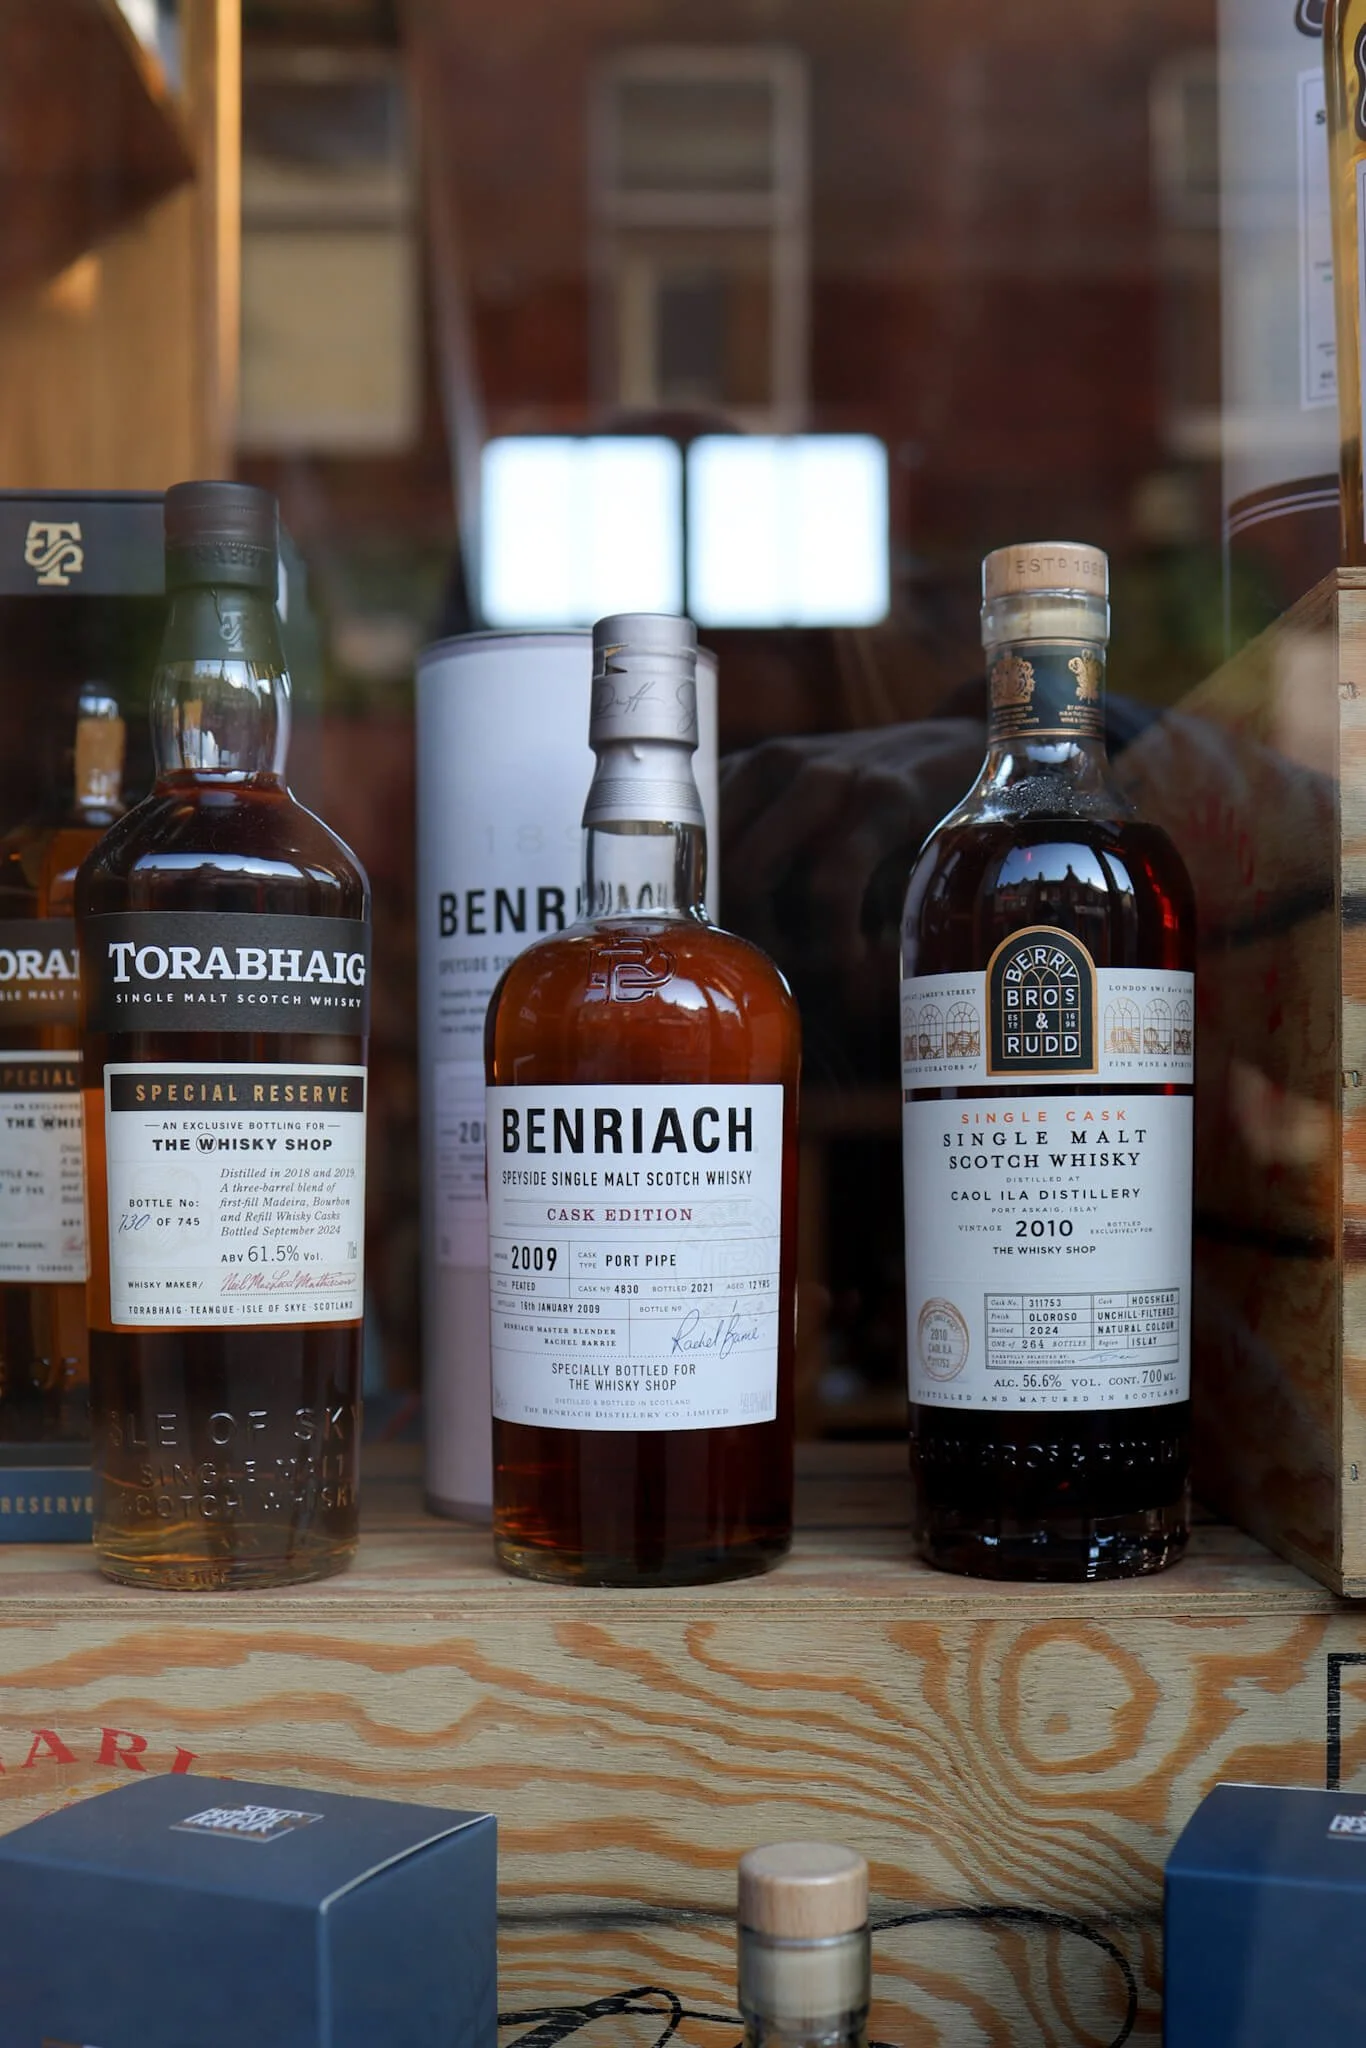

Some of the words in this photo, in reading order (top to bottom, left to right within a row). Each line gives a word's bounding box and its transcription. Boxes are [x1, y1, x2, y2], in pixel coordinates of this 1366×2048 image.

[0, 949, 80, 982] ORA
[108, 941, 366, 986] TORABHAIG
[1006, 948, 1077, 983] BERRY
[116, 993, 174, 1004] SINGLE
[184, 993, 228, 1004] MALT
[237, 993, 301, 1005] SCOTCH
[311, 995, 362, 1008] WHISKY
[1007, 987, 1075, 1006] BROS
[1035, 1012, 1049, 1030] &
[1008, 1035, 1078, 1053] RUDD
[2, 1070, 76, 1085] PECIAL
[135, 1084, 237, 1101] SPECIAL
[253, 1084, 349, 1103] RESERVE
[961, 1111, 1048, 1124] SINGLE
[1066, 1110, 1127, 1122] CASK
[162, 1121, 177, 1130] AN
[183, 1121, 243, 1130] EXCLUSIVE
[249, 1121, 301, 1130] BOTTLING
[306, 1121, 325, 1130] FOR
[502, 1106, 753, 1154] BENRIACH
[152, 1138, 191, 1151] THE
[197, 1137, 277, 1151] WHISKY
[285, 1138, 333, 1151] SHOP
[943, 1131, 1049, 1147] SINGLE
[1070, 1129, 1148, 1145] MALT
[949, 1154, 1040, 1170] SCOTCH
[1049, 1152, 1141, 1168] WHISKY
[220, 1168, 266, 1178] Distilled
[270, 1168, 280, 1178] in
[283, 1168, 310, 1178] 2018
[313, 1168, 331, 1178] and
[502, 1170, 547, 1186] SPEYSIDE
[551, 1171, 598, 1187] SINGLE
[604, 1171, 640, 1187] MALT
[646, 1171, 700, 1186] SCOTCH
[706, 1169, 752, 1185] WHISKY
[220, 1184, 228, 1193] A
[233, 1183, 294, 1193] three-barrel
[297, 1183, 323, 1193] blend
[326, 1182, 337, 1194] of
[951, 1190, 991, 1201] CAOL
[1000, 1189, 1029, 1201] ILA
[1039, 1188, 1142, 1200] DISTILLERY
[129, 1199, 173, 1208] BOTTLE
[219, 1197, 258, 1209] first-fill
[262, 1197, 310, 1208] Madeira,
[313, 1197, 351, 1207] Bourbon
[1069, 1205, 1099, 1213] ISLAY
[156, 1217, 172, 1226] OF
[177, 1217, 200, 1226] 745
[220, 1213, 241, 1222] and
[245, 1212, 272, 1222] Refill
[276, 1212, 311, 1224] Whisky
[314, 1212, 341, 1221] Casks
[547, 1208, 595, 1222] CASK
[604, 1207, 693, 1222] EDITION
[220, 1226, 259, 1237] Bottled
[262, 1225, 315, 1239] September
[318, 1225, 342, 1236] 2024
[958, 1224, 1003, 1233] VINTAGE
[1015, 1219, 1074, 1238] 2010
[220, 1253, 244, 1263] ABV
[247, 1244, 300, 1263] 61.5%
[303, 1252, 323, 1261] Vol.
[993, 1246, 1014, 1255] THE
[1017, 1246, 1062, 1255] WHISKY
[1066, 1245, 1096, 1255] SHOP
[511, 1245, 557, 1271] 2009
[577, 1251, 598, 1259] CASK
[605, 1254, 639, 1267] PORT
[645, 1254, 677, 1267] PIPE
[128, 1281, 161, 1289] WHISKY
[511, 1280, 536, 1291] PEATED
[577, 1285, 598, 1293] CASK
[613, 1284, 640, 1295] 4830
[652, 1285, 688, 1293] BOTTLED
[690, 1283, 714, 1294] 2021
[129, 1305, 182, 1315] TORABHAIG
[190, 1305, 234, 1314] TEANGUE
[242, 1304, 263, 1313] ISLE
[268, 1304, 280, 1312] OF
[285, 1303, 307, 1312] SKYE
[314, 1301, 353, 1311] SCOTLAND
[538, 1302, 574, 1313] JANUARY
[577, 1304, 600, 1314] 2009
[1029, 1298, 1062, 1308] 311753
[1131, 1294, 1175, 1305] HOGSHEAD
[1029, 1312, 1077, 1322] OLOROSO
[537, 1326, 570, 1334] MASTER
[573, 1328, 617, 1336] BLENDER
[1029, 1326, 1059, 1335] 2024
[1097, 1325, 1142, 1335] NATURAL
[544, 1337, 578, 1346] RACHEL
[581, 1339, 617, 1347] BARRIE
[552, 1362, 610, 1377] SPECIALLY
[615, 1363, 668, 1377] BOTTLED
[674, 1363, 697, 1376] FOR
[569, 1378, 590, 1391] THE
[594, 1379, 640, 1392] WHISKY
[644, 1378, 678, 1391] SHOP
[993, 1378, 1019, 1388] ALC.
[1023, 1373, 1063, 1388] 56.6%
[1071, 1377, 1101, 1388] VOL.
[1108, 1375, 1140, 1386] CONT.
[1142, 1369, 1163, 1384] 700
